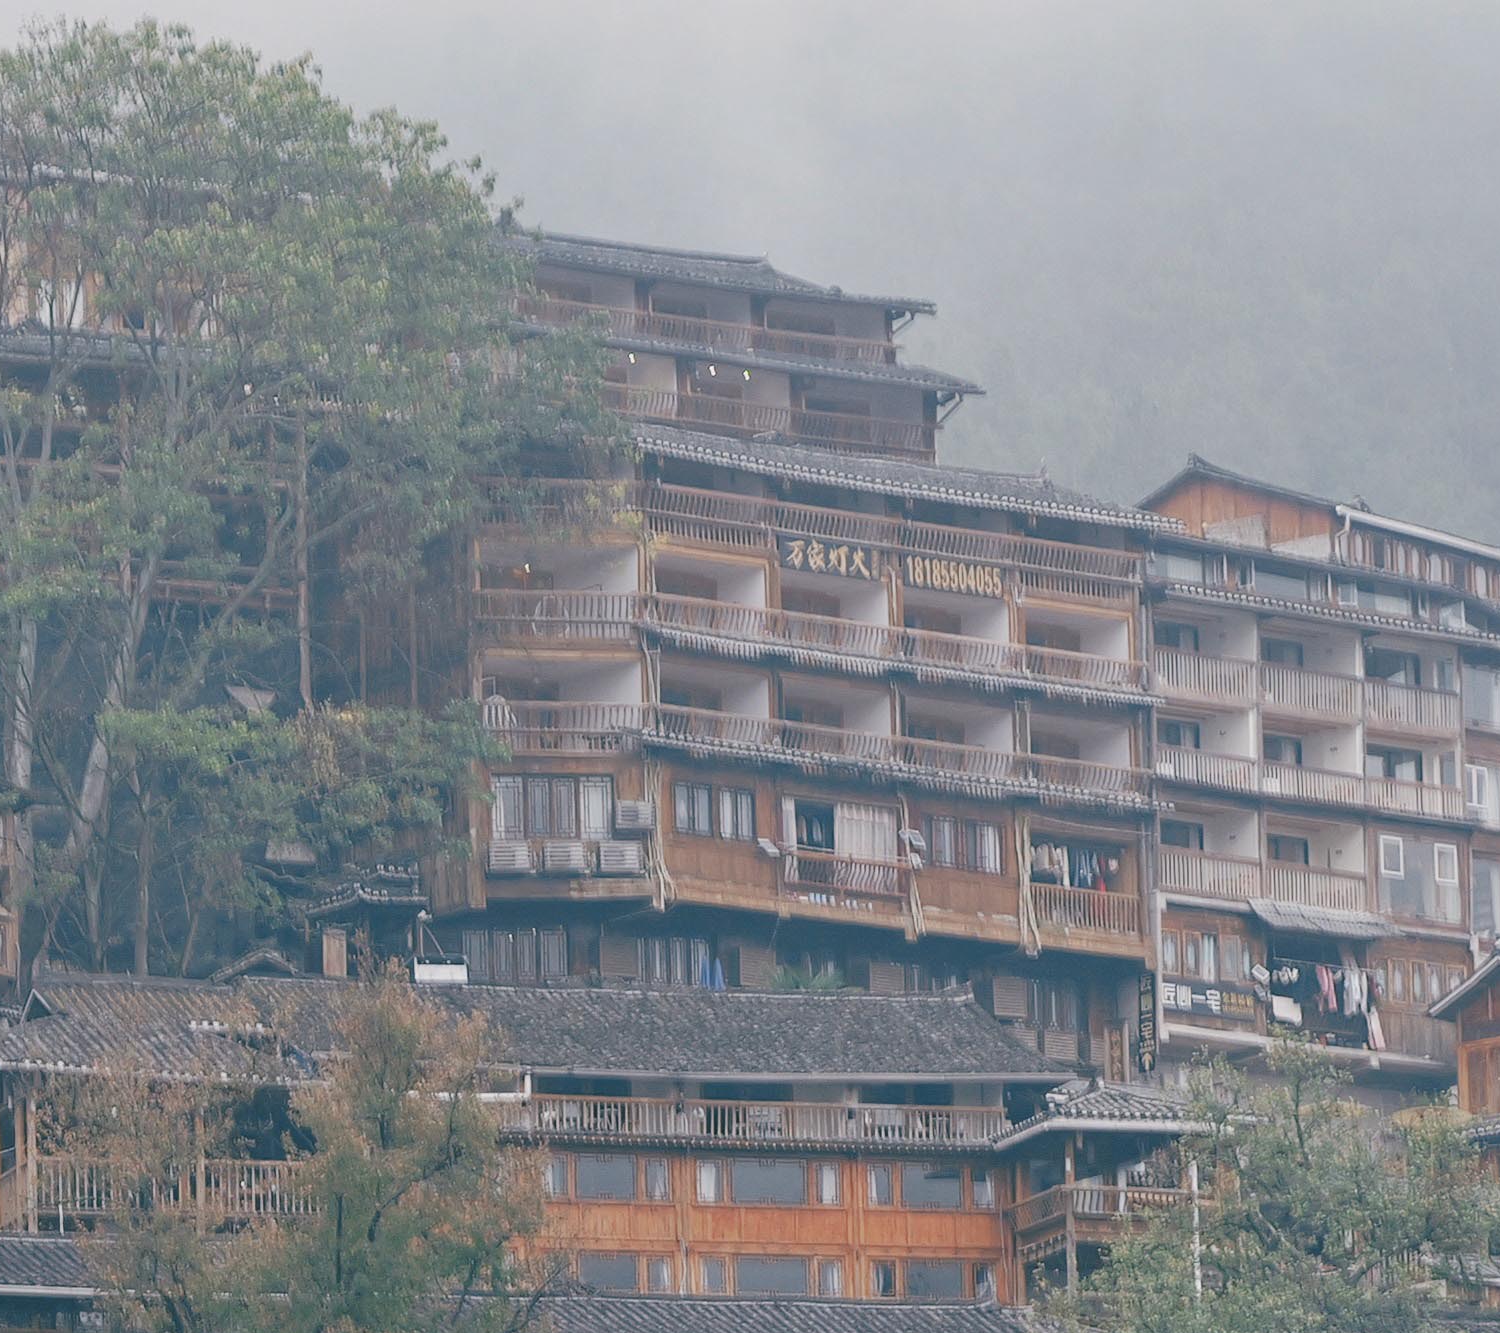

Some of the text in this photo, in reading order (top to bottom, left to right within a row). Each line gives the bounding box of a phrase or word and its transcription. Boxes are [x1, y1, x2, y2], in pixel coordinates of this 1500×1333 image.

[786, 539, 871, 580] 万家灯火
[906, 555, 1003, 598] 18185504055
